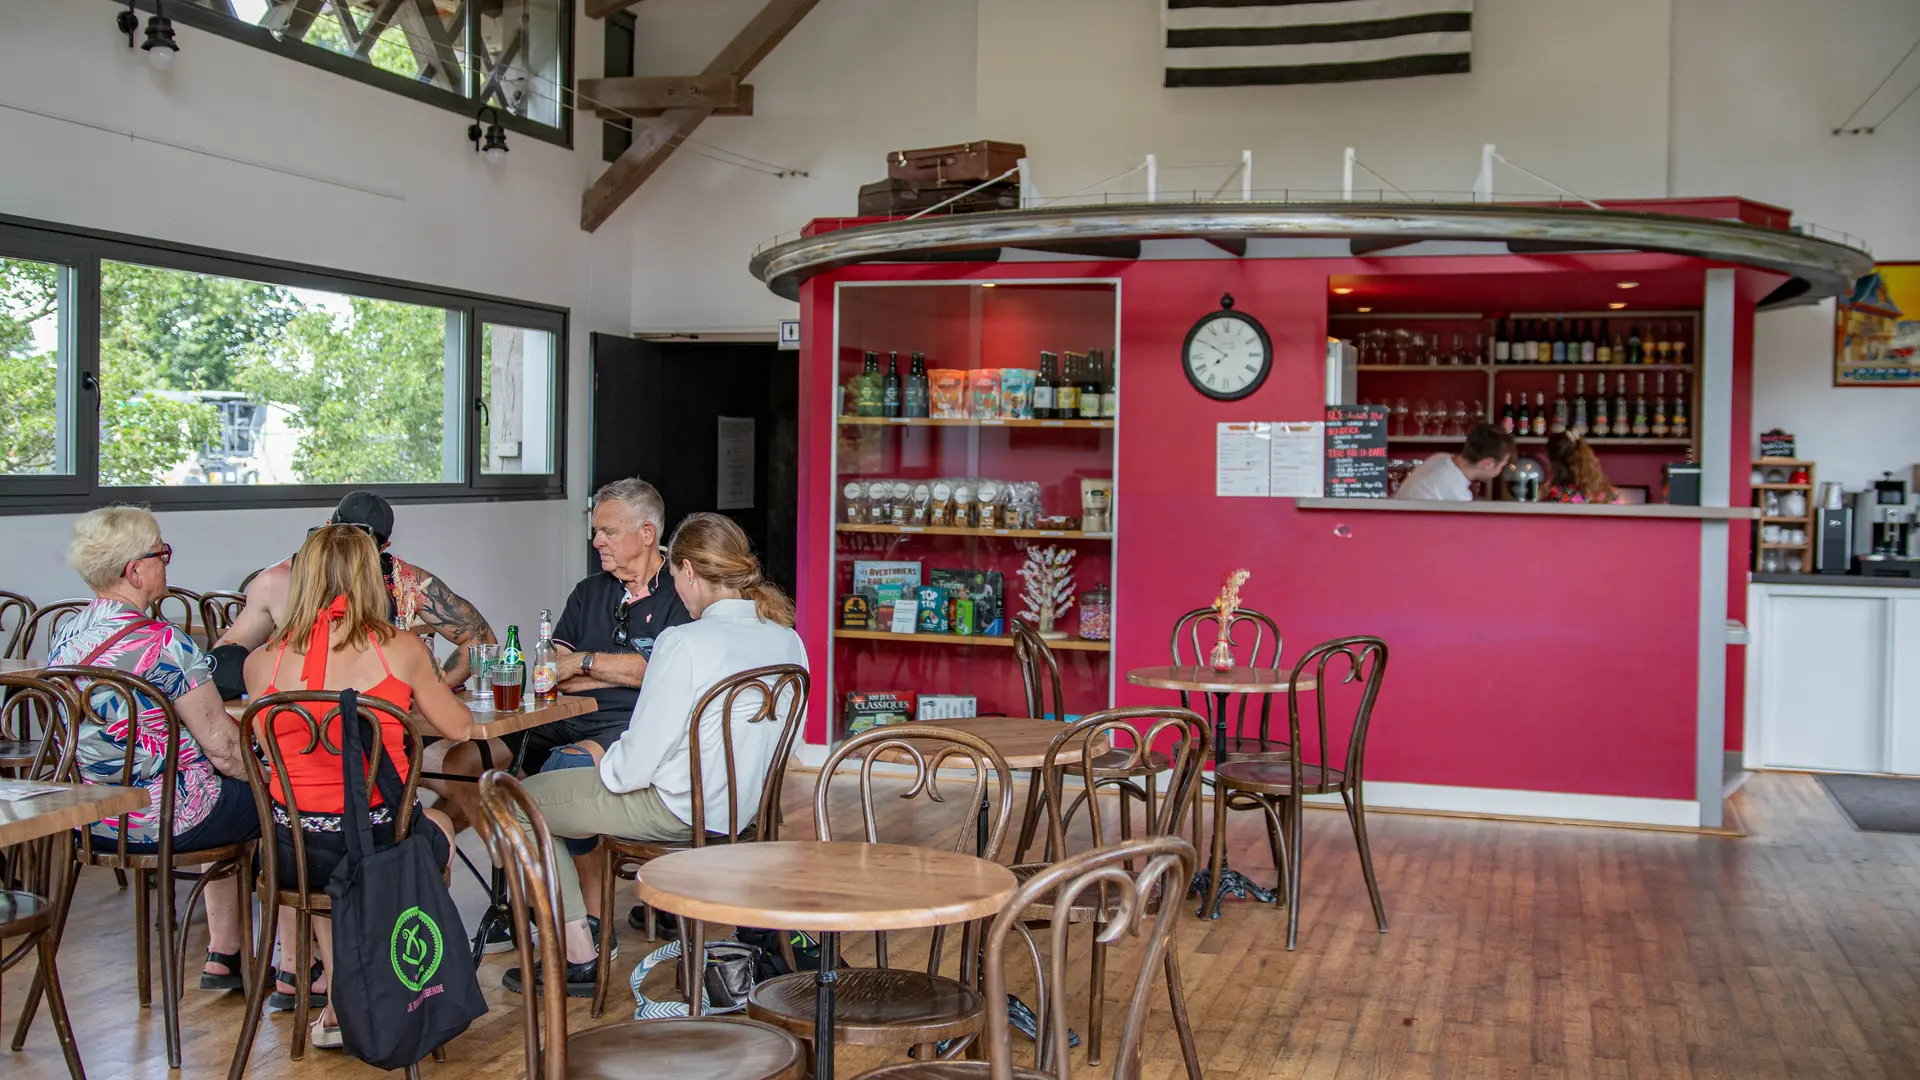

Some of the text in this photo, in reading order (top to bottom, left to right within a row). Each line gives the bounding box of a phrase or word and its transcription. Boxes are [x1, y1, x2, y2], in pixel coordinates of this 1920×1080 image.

[869, 567, 917, 576] AVENTURIERS
[920, 589, 938, 600] TOP
[921, 600, 936, 609] TEN
[879, 693, 897, 702] JEUX
[854, 700, 910, 710] CLASSIQUES
